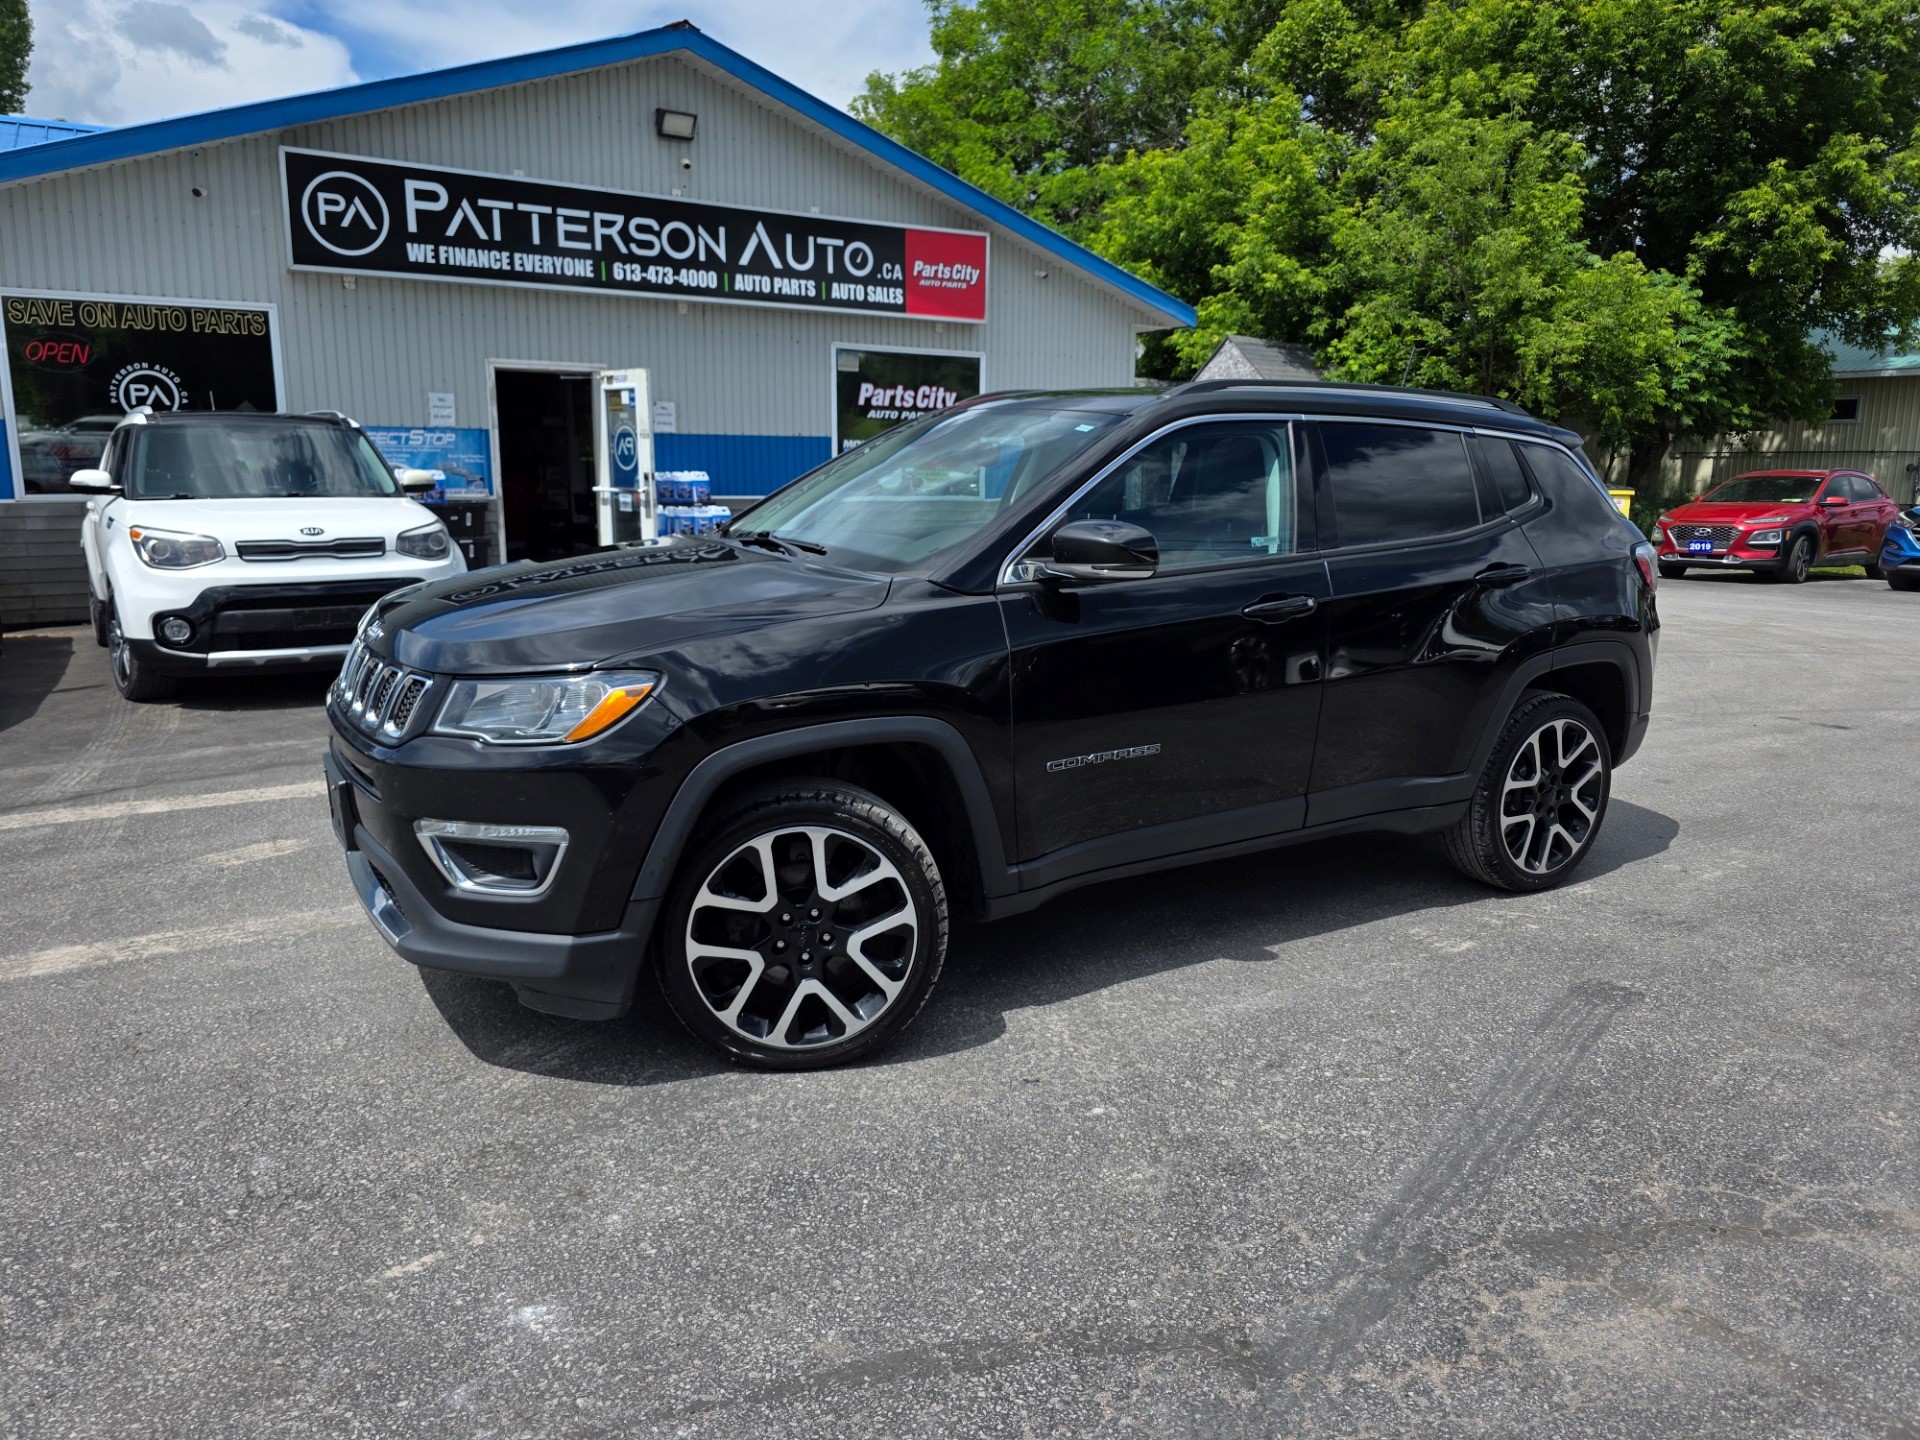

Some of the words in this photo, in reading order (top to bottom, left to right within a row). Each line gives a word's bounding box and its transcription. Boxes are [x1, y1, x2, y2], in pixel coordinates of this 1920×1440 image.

[404, 178, 727, 263] PATTERSON
[406, 242, 436, 264] WE
[439, 246, 511, 270] FINANCE
[514, 252, 594, 278] EVERYONE
[613, 261, 717, 289] 613-473-4000
[734, 273, 771, 293] AUTO
[773, 277, 816, 297] PARTS
[831, 282, 865, 301] AUTO
[867, 286, 904, 305] SALES
[919, 279, 940, 287] AUTO
[942, 281, 967, 289] PARTS
[8, 298, 75, 326] SAVE
[79, 302, 116, 328] ON
[121, 305, 187, 331] AUTO
[191, 308, 266, 336] PARTS
[25, 341, 89, 364] OPEN
[110, 362, 148, 404] PATTERSON
[154, 364, 180, 383] AUTO
[867, 409, 899, 420] AUTO
[1689, 542, 1712, 550] 2019
[1046, 743, 1161, 773] COMPASS
